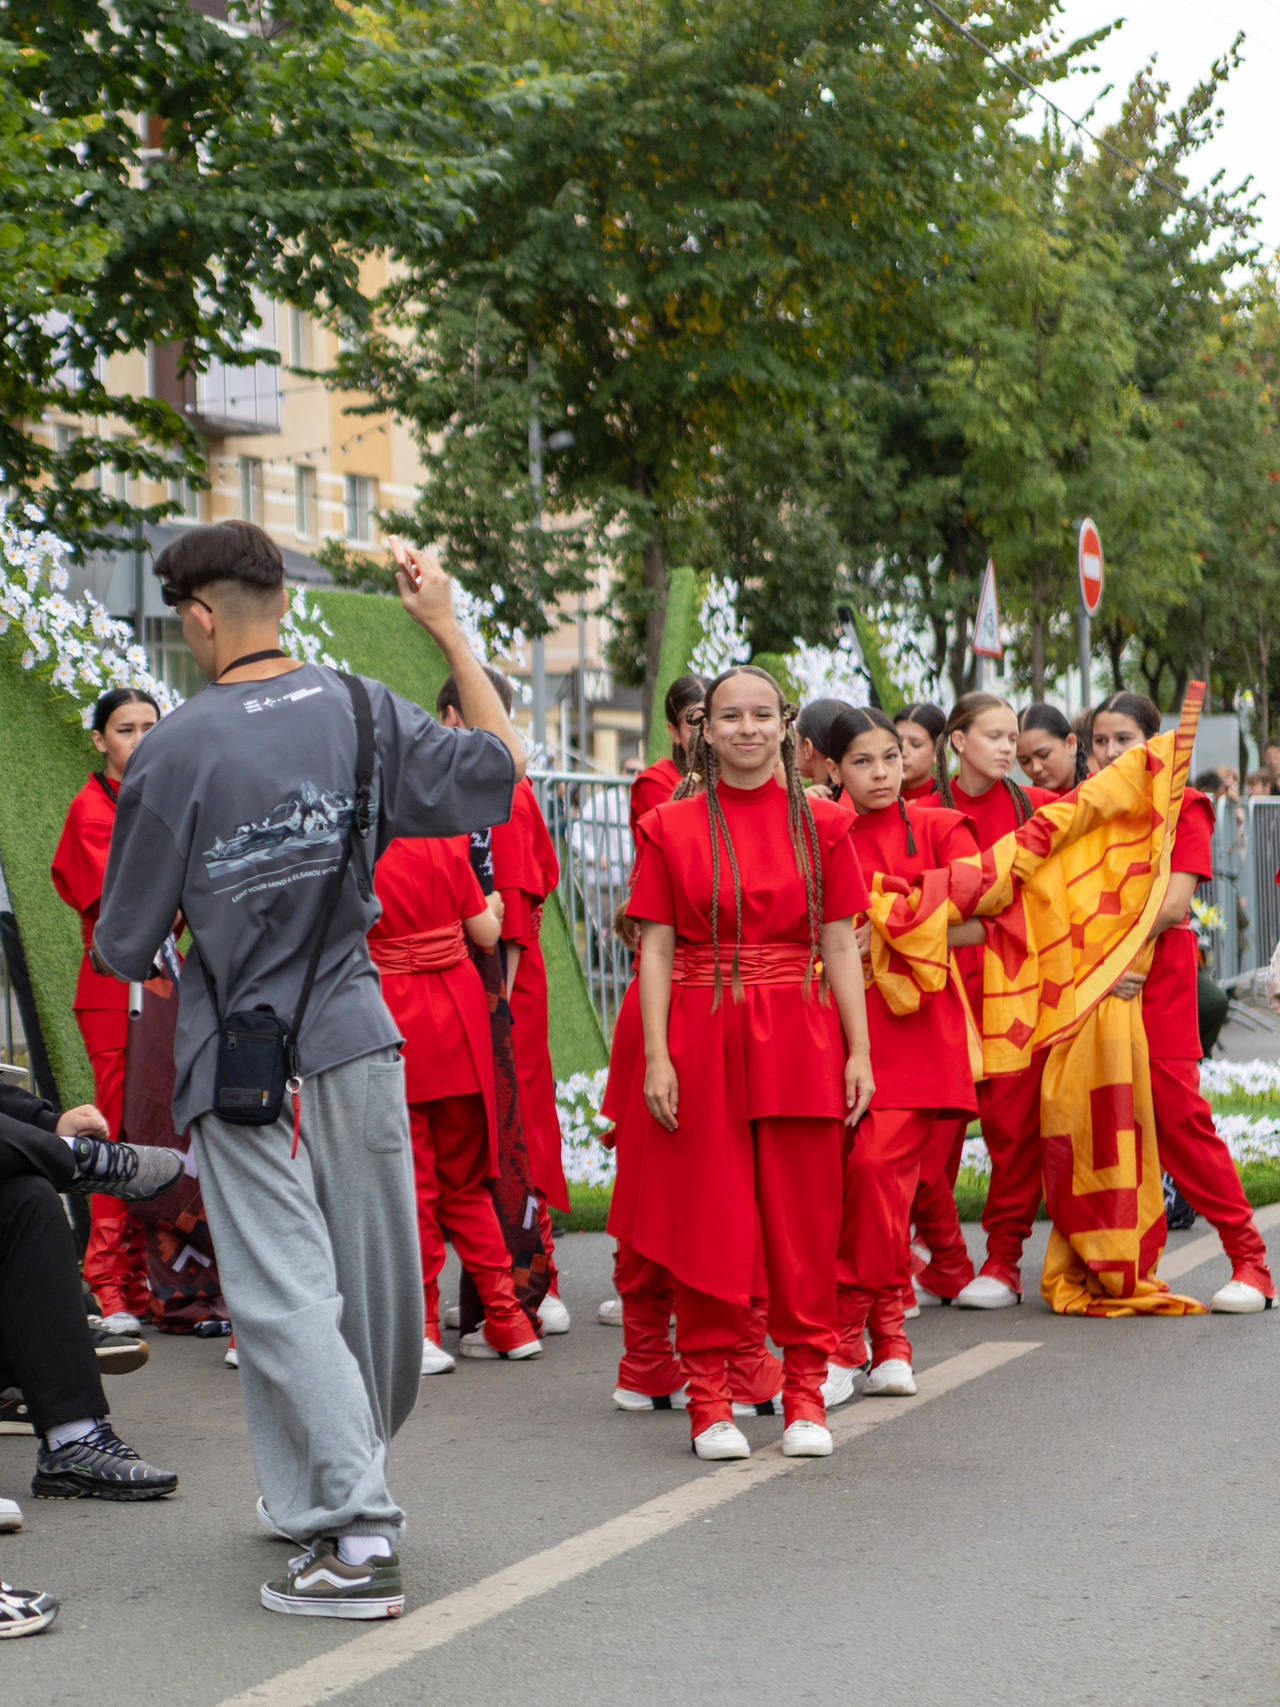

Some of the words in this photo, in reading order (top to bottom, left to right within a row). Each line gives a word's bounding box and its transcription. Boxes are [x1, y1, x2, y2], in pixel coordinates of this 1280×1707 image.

[231, 889, 248, 903] LIGHT
[248, 883, 267, 893] YOUR
[268, 878, 287, 889] MIND
